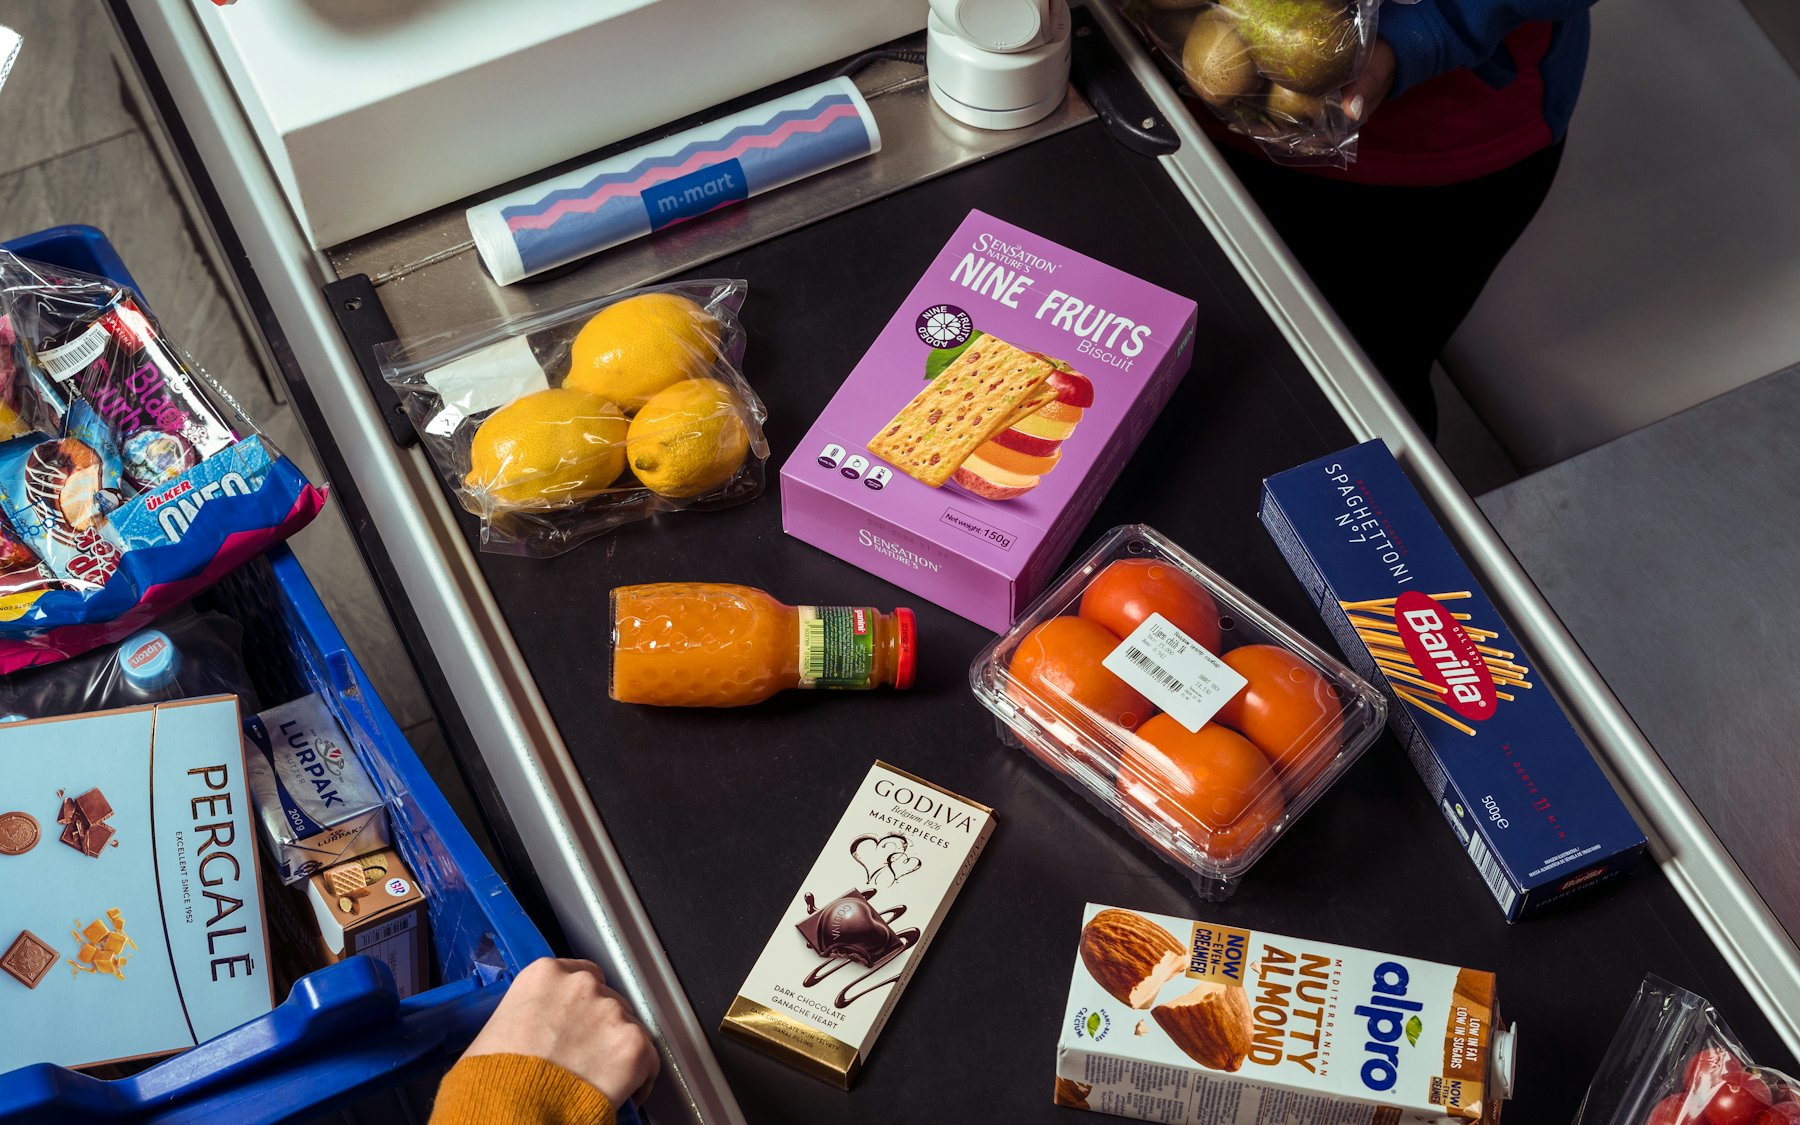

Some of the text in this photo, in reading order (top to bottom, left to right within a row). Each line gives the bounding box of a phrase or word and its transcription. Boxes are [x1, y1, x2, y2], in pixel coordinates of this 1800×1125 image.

[972, 233, 1056, 274] SENSATION
[923, 306, 947, 320] NINE
[950, 252, 1034, 309] NINE
[1035, 290, 1152, 357] FRUITS
[918, 327, 948, 348] ADDED
[957, 312, 970, 343] FRUITS
[1077, 339, 1135, 373] Biscuit
[145, 480, 193, 512] ÜLKER
[983, 527, 1011, 548] 150g
[1325, 464, 1413, 584] SPAGHETTONI
[858, 529, 939, 573] SENSATION
[131, 640, 164, 665] Lipton
[1452, 626, 1468, 645] DAL
[1402, 608, 1483, 706] Barilla
[279, 720, 343, 809] LURPAK
[284, 753, 306, 785] BUTTER
[288, 808, 306, 832] 200g
[874, 779, 972, 834] GODIVA
[891, 804, 922, 825] Belgium
[317, 829, 359, 847] LURPAK
[868, 809, 950, 850] MASTERPIECES
[175, 831, 194, 924] EXCELLENT SINCE 1952
[831, 903, 853, 939] GODIVA
[1190, 928, 1213, 974] CREAMIER
[1210, 943, 1224, 965] EVEN
[1222, 934, 1245, 980] NOW
[771, 996, 839, 1030] GANACHE HEART
[774, 984, 847, 1022] DARK CHOCOLATE
[1247, 944, 1297, 1066] ALMOND
[1286, 952, 1331, 1074] NUTTY
[1320, 958, 1343, 1076] MEDITERRANEAN
[1073, 1007, 1088, 1038] CALCIUM
[1095, 1008, 1111, 1042] PLANT-BASED
[1354, 961, 1424, 1092] alpro
[1450, 1006, 1468, 1069] LOW IN SUGARS
[1465, 1017, 1481, 1062] LOW IN FAT
[1450, 1080, 1462, 1107] NOW
